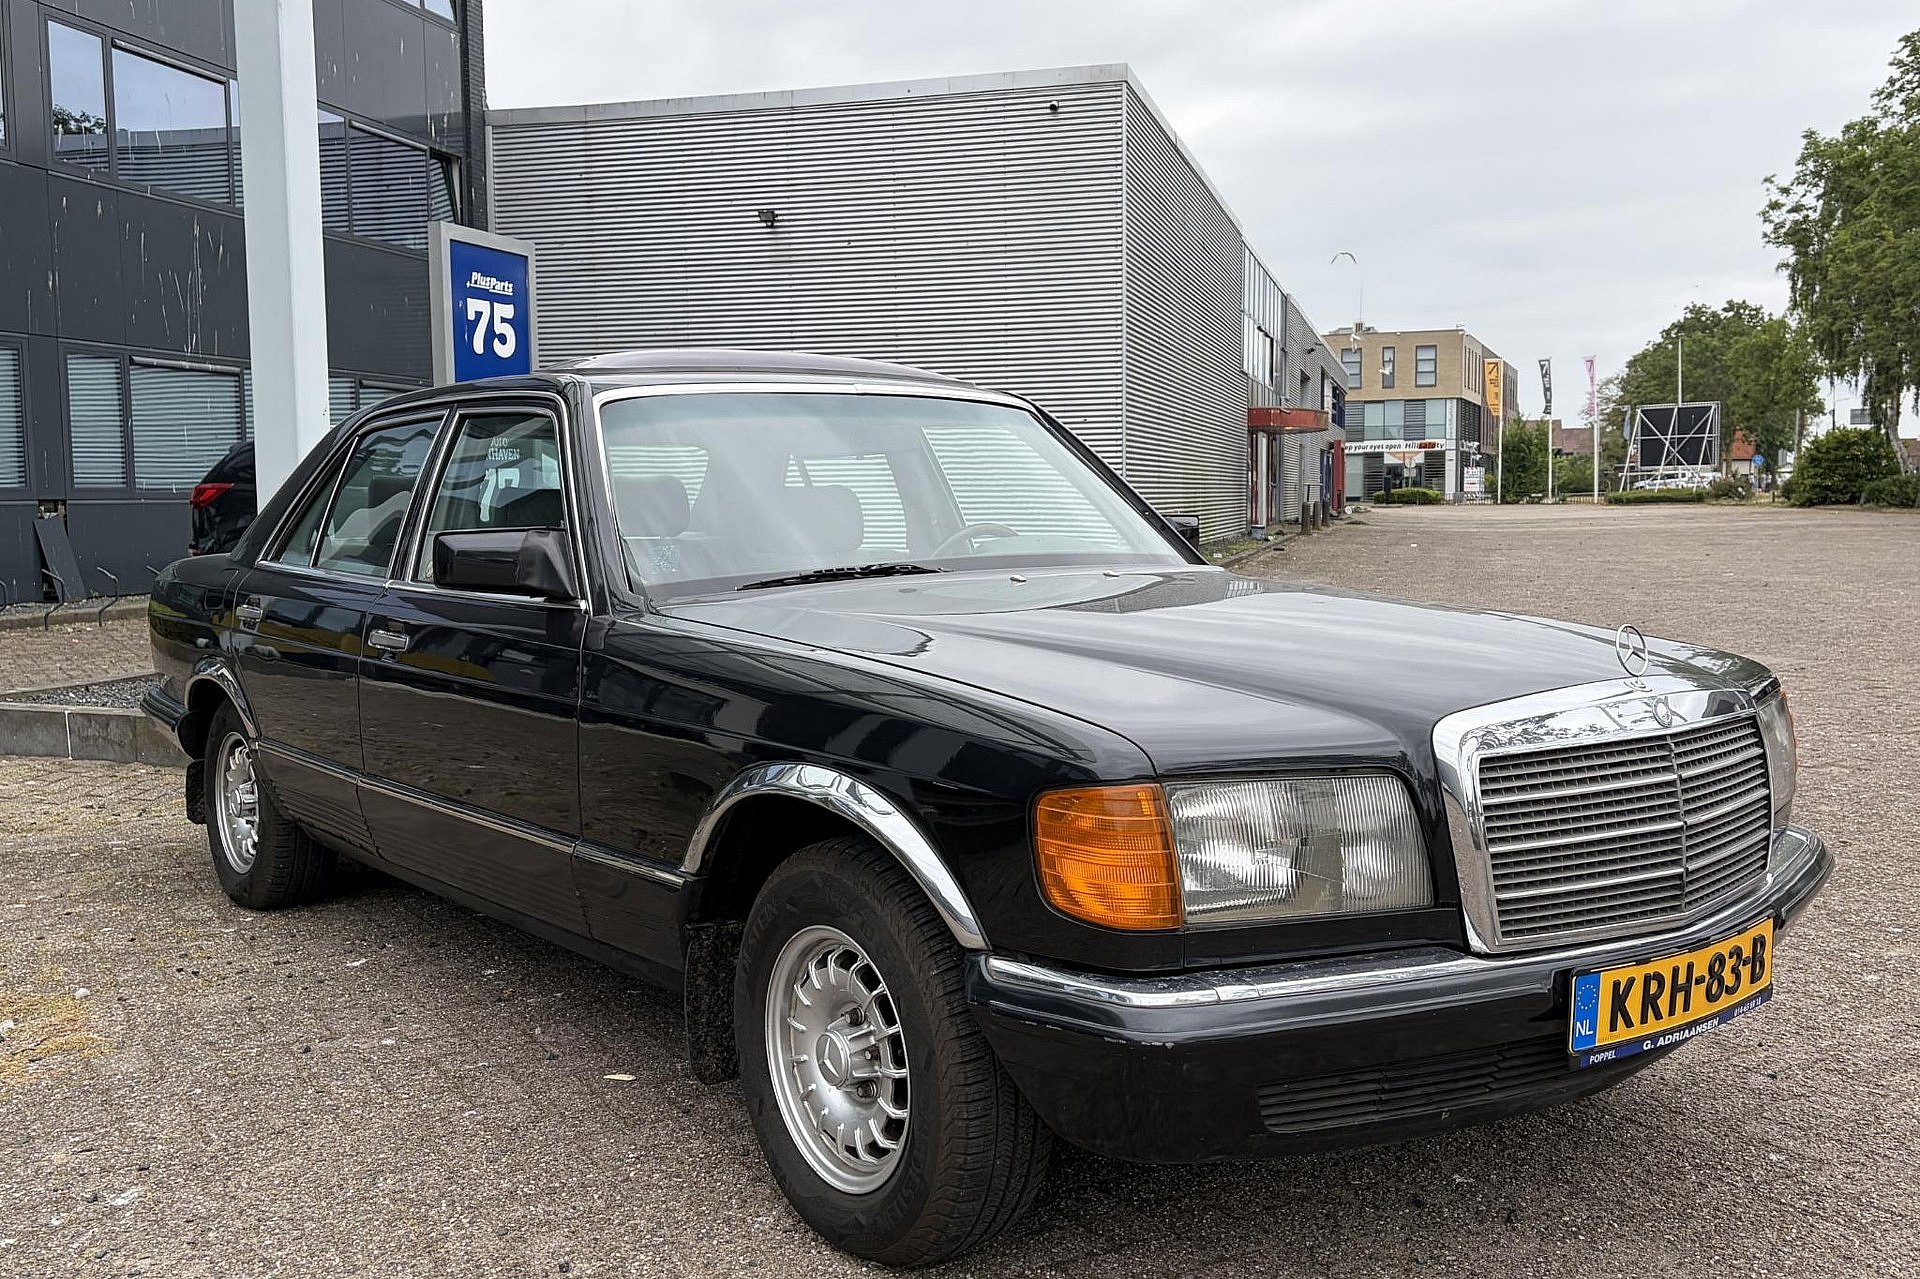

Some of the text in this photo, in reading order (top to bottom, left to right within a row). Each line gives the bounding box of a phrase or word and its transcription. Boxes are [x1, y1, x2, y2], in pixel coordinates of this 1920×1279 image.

[471, 271, 514, 294] PlusParts
[466, 297, 517, 358] 75
[1385, 443, 1401, 451] open
[1609, 933, 1767, 1032] KRH-83-B
[1575, 1019, 1594, 1037] NL
[1589, 1050, 1617, 1065] POPPEL
[1643, 1039, 1654, 1051] G.
[1656, 1016, 1720, 1047] ADRIAANSEN
